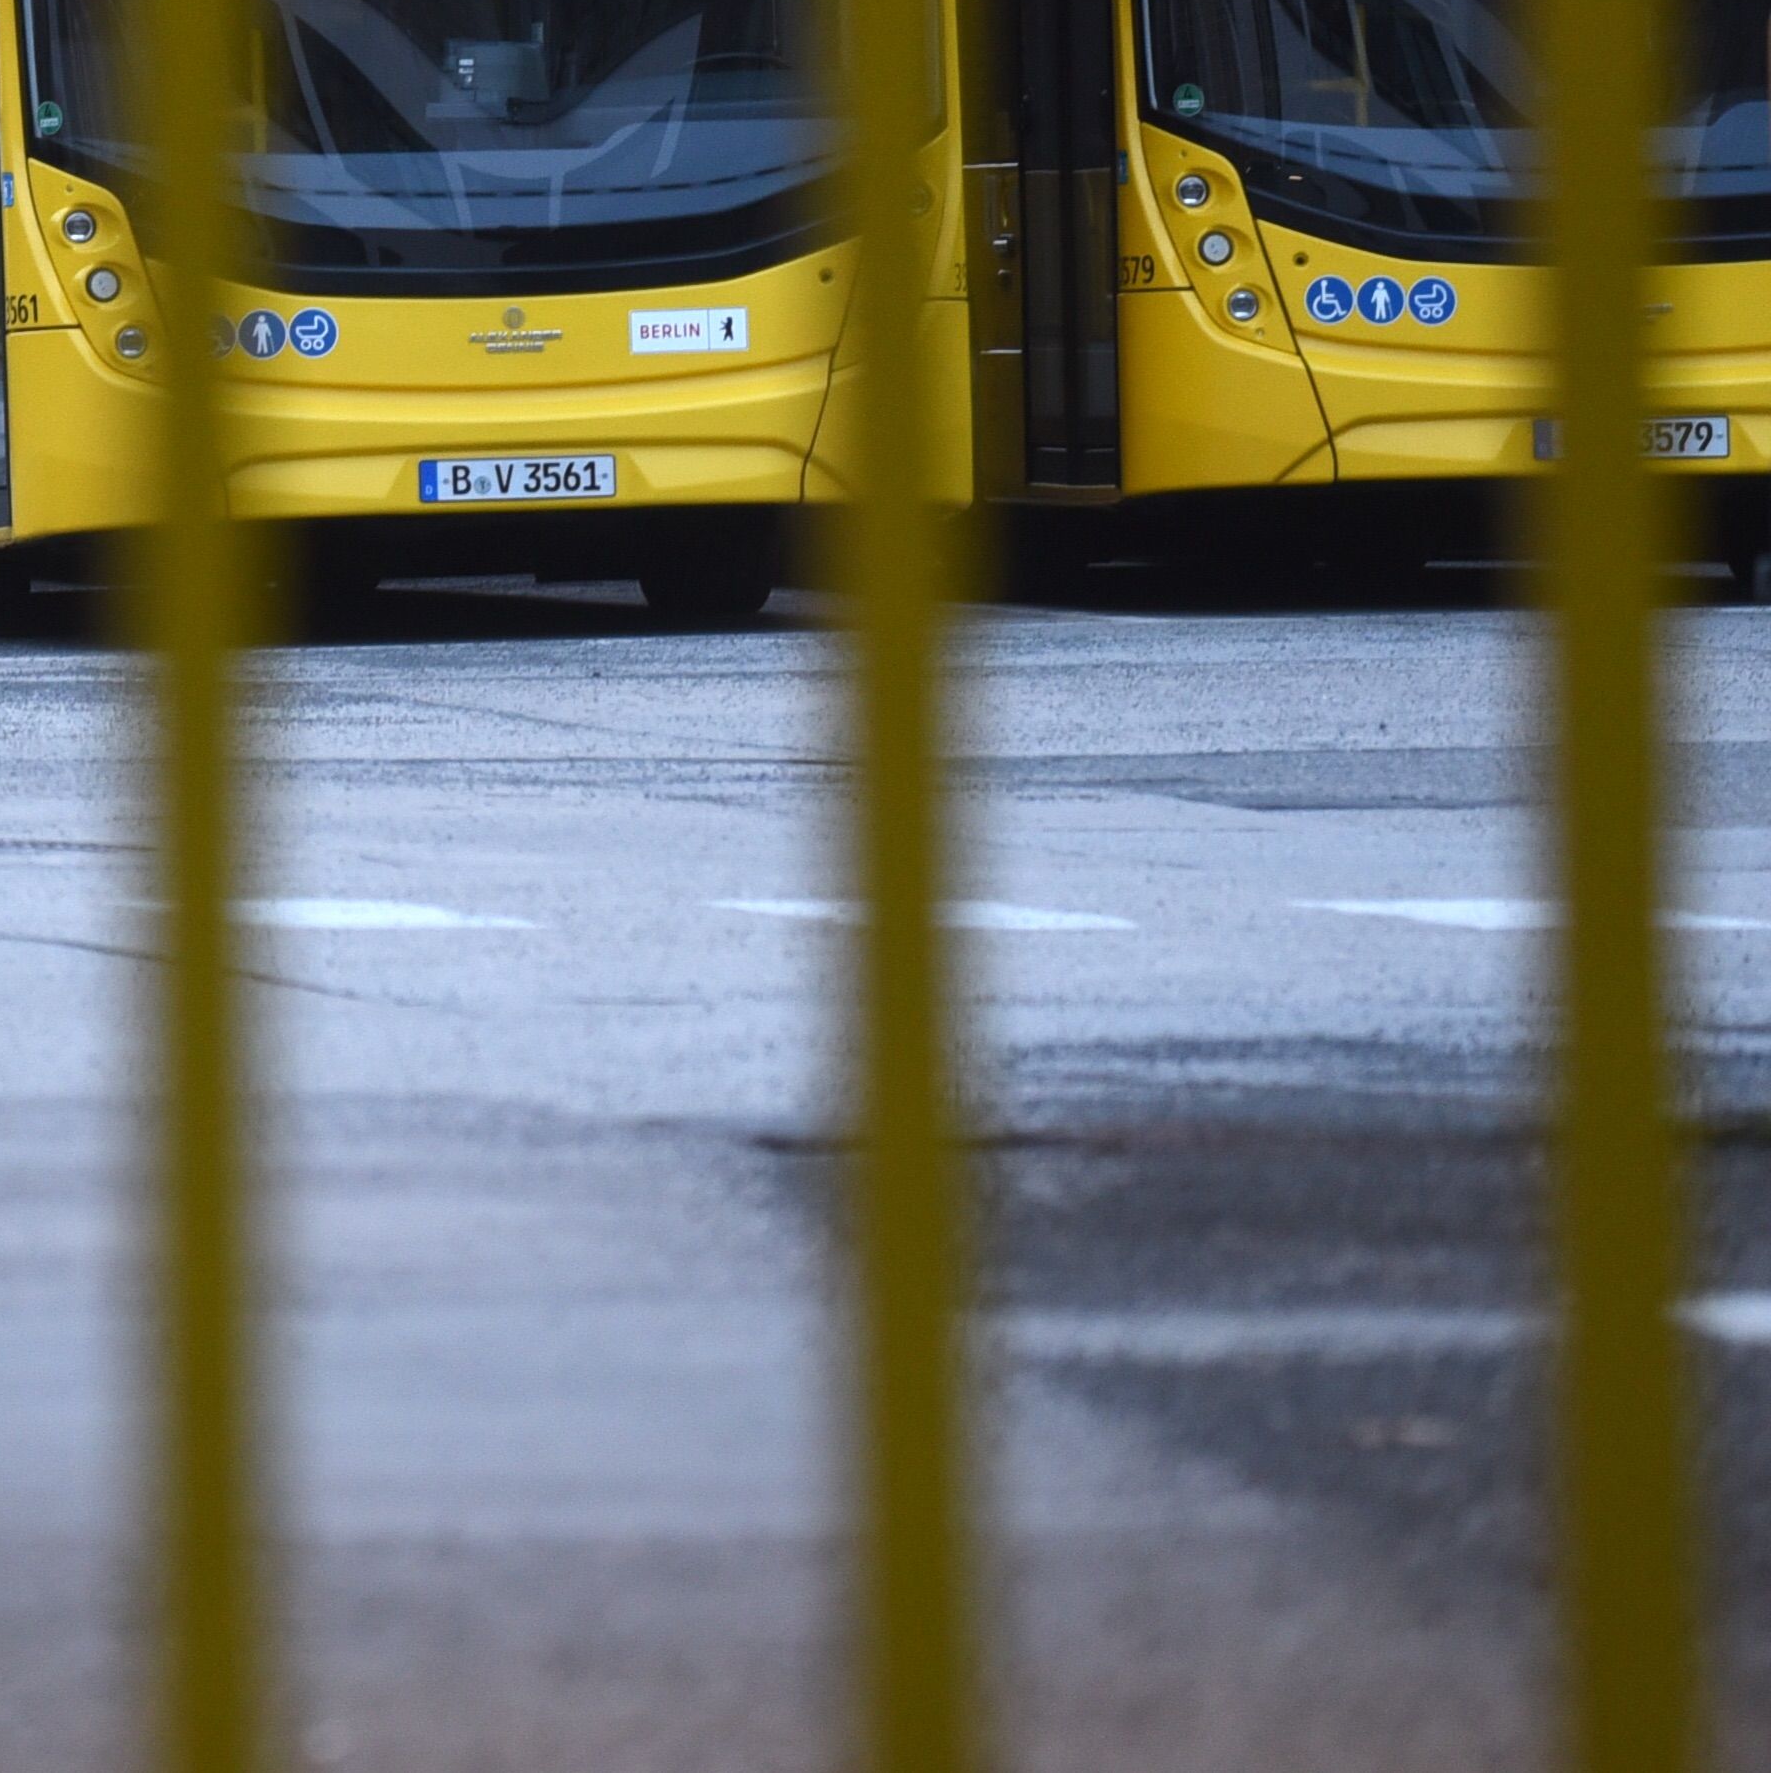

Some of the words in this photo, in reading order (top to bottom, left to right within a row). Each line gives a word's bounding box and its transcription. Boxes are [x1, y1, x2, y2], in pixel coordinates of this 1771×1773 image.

[640, 323, 700, 339] BERLIN
[452, 465, 472, 496] B
[495, 464, 514, 494] V
[524, 461, 601, 493] 3561
